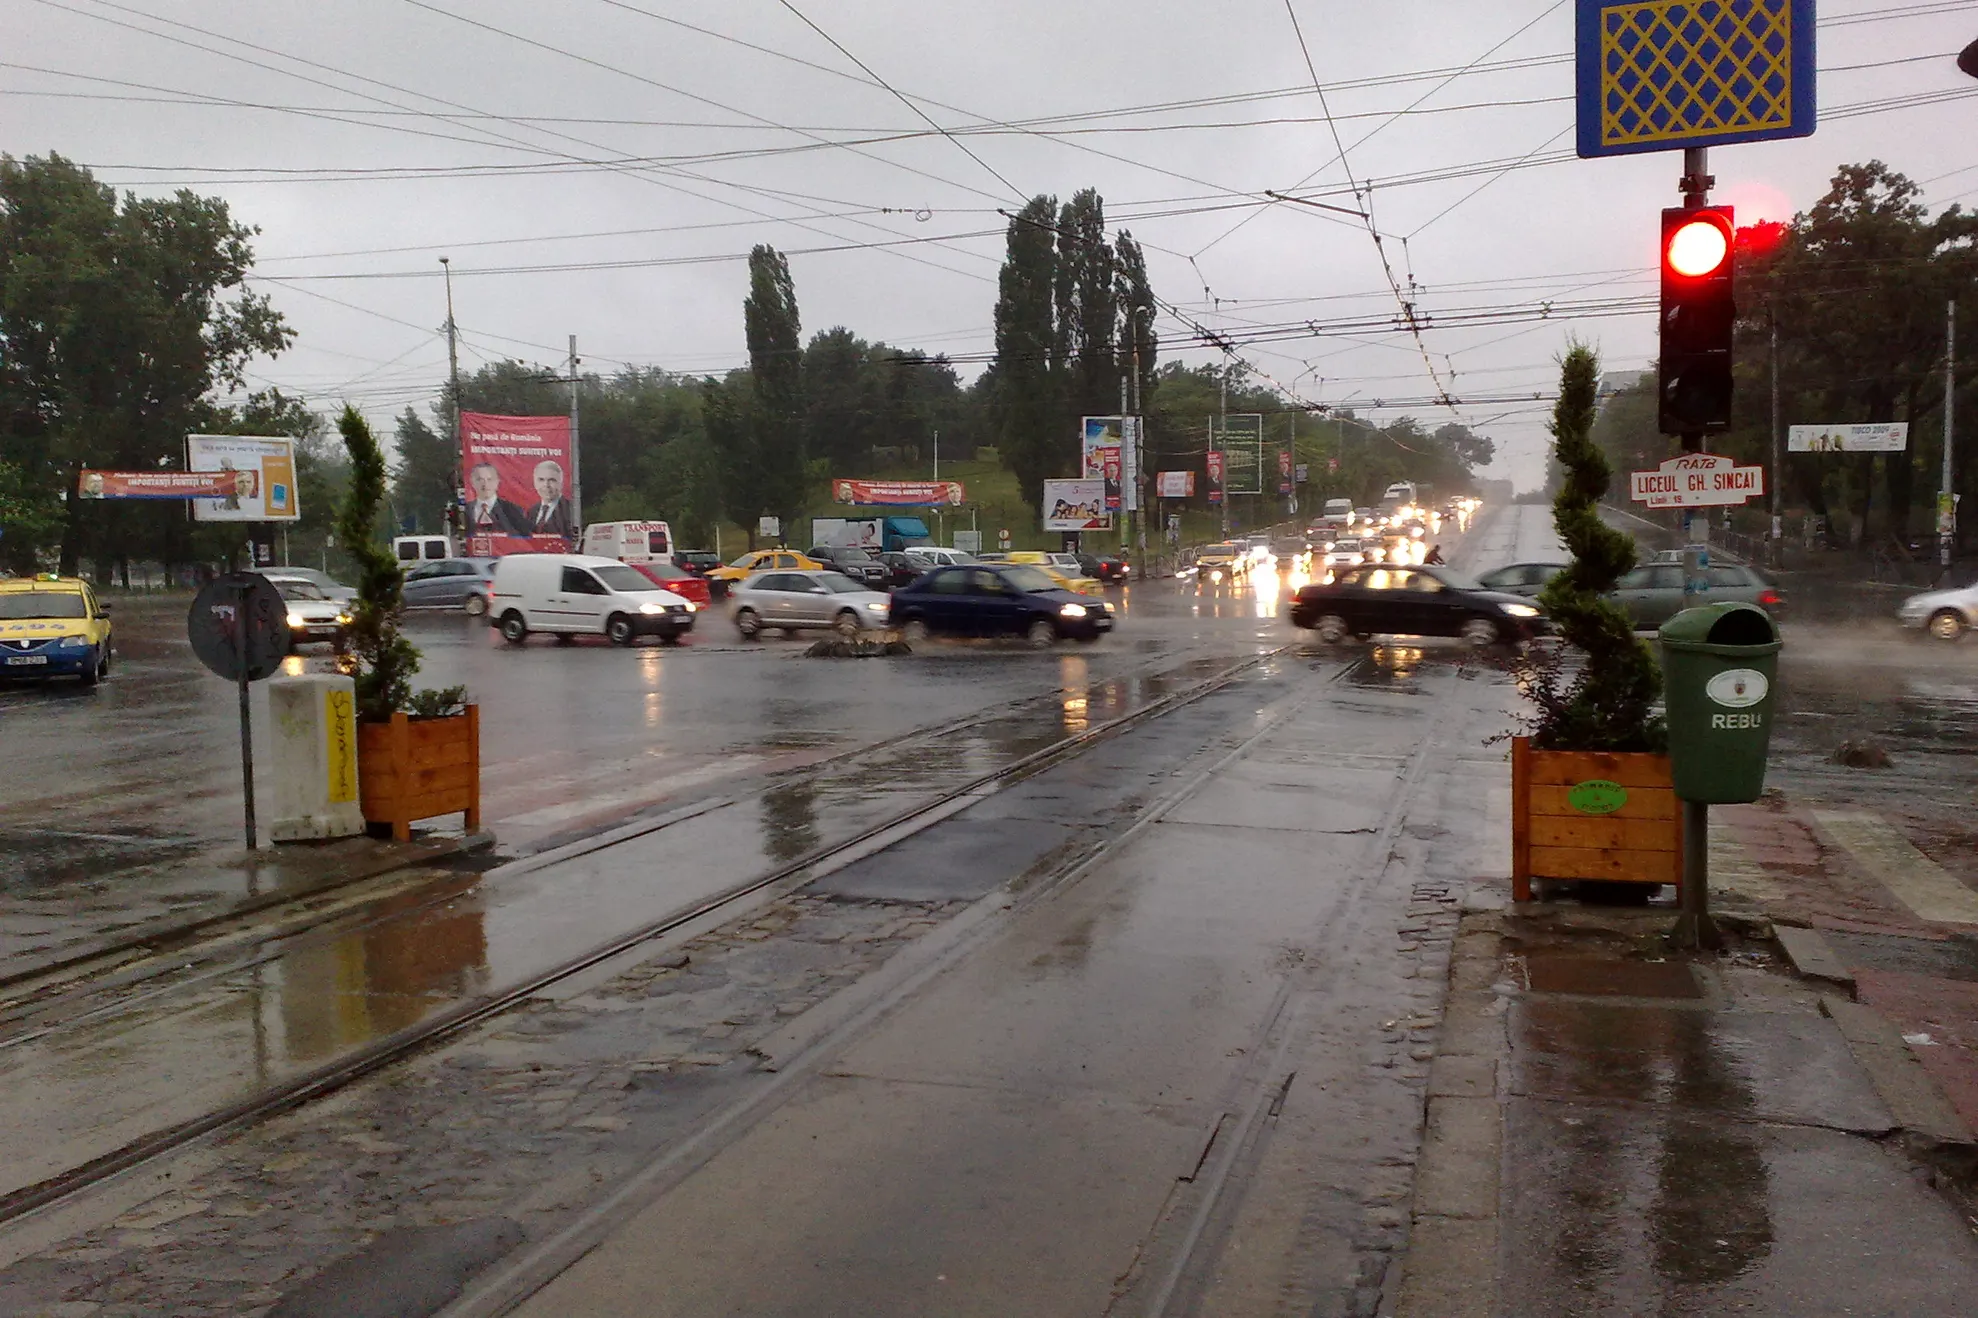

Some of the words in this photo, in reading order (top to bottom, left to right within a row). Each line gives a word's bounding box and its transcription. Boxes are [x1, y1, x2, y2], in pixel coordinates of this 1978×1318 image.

[1676, 458, 1717, 470] RATB
[1638, 475, 1678, 493] LICEUL
[1714, 472, 1754, 490] SINCAI
[624, 523, 666, 532] TRANSPORT
[1711, 712, 1762, 729] REBU
